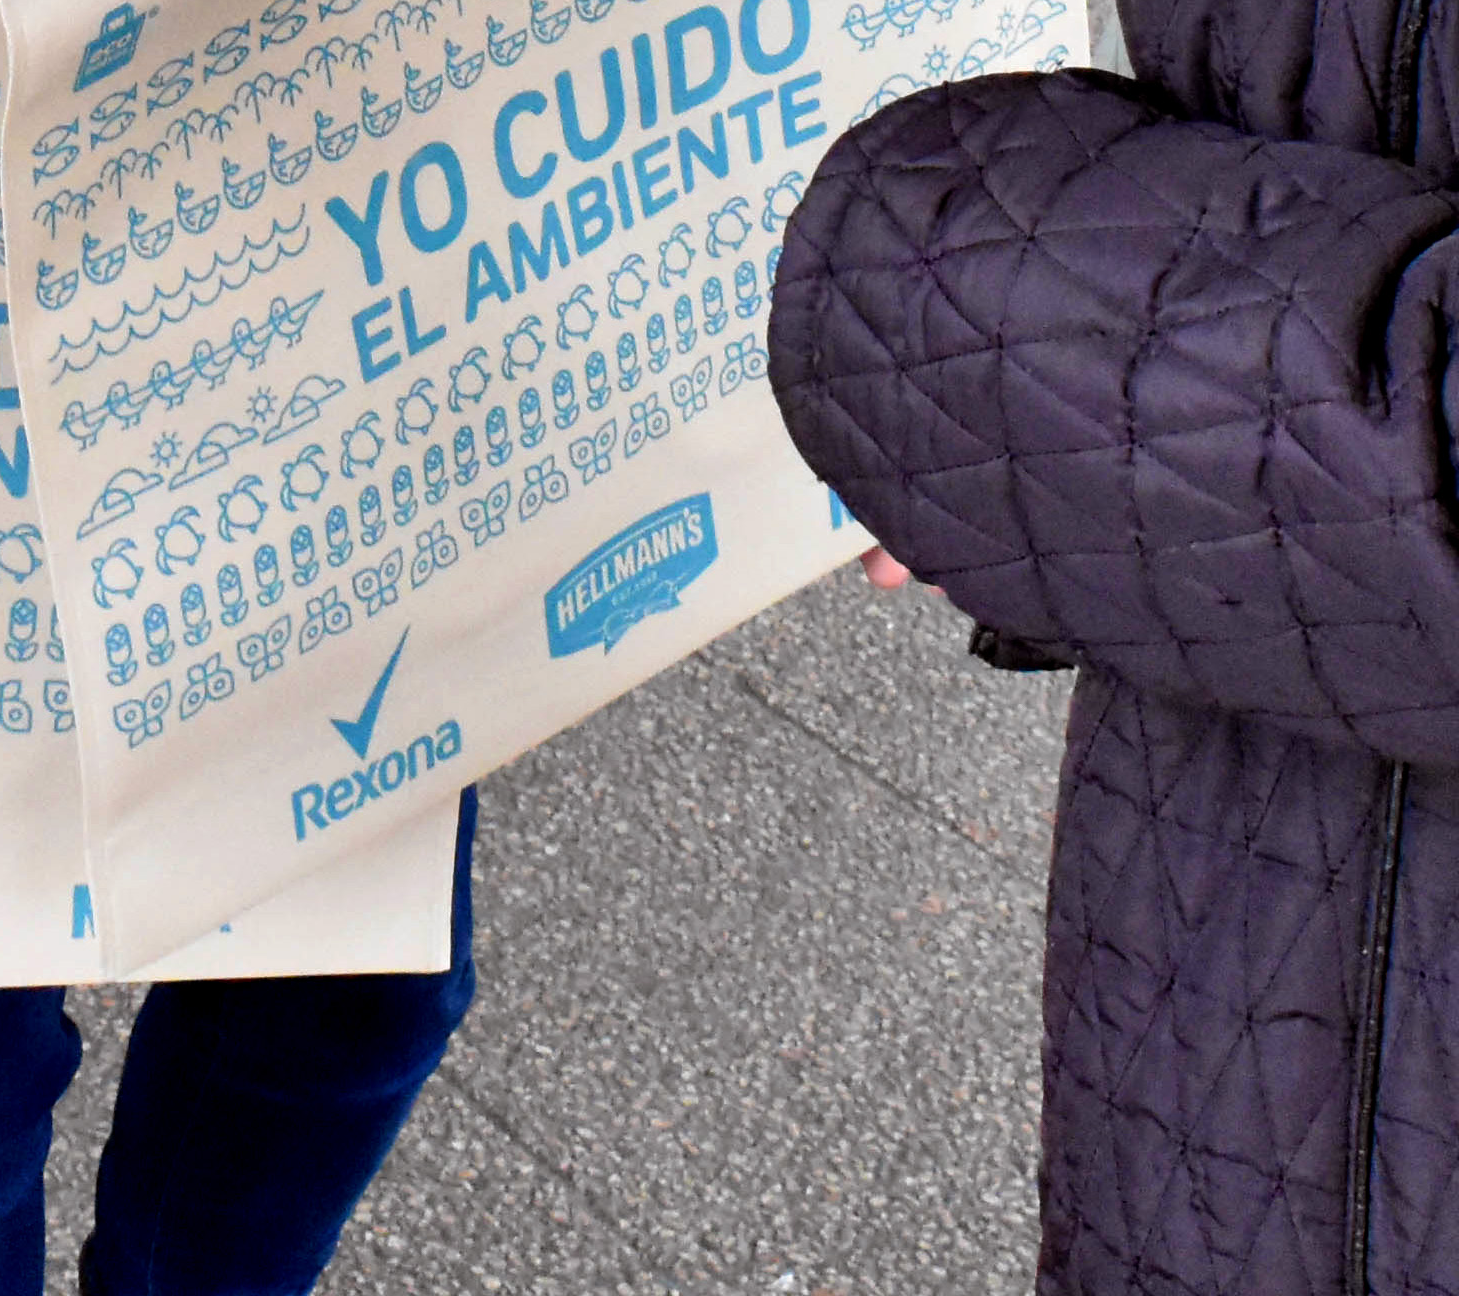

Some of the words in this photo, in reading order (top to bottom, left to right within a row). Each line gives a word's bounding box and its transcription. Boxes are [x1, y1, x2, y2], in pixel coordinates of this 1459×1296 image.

[326, 143, 469, 286] YO
[351, 287, 447, 382] EL
[466, 72, 829, 323] AMBIENTE
[557, 507, 704, 632] HELLMANN'S
[291, 716, 462, 842] Rexona
